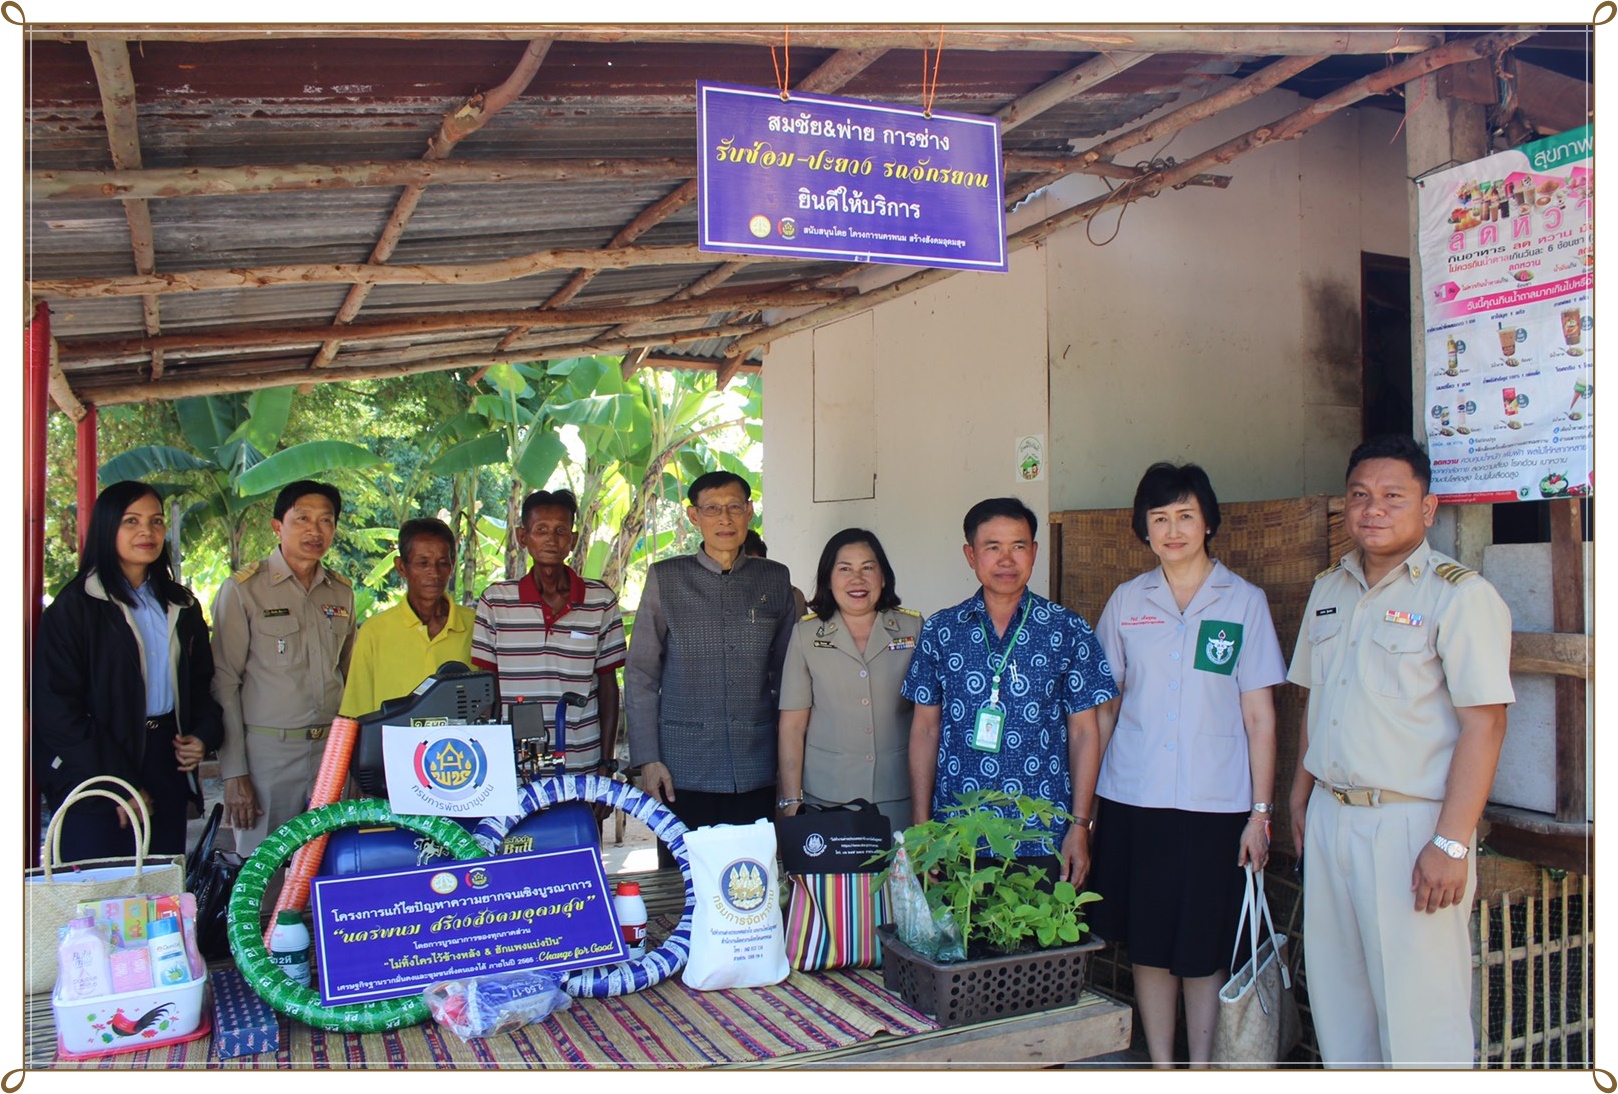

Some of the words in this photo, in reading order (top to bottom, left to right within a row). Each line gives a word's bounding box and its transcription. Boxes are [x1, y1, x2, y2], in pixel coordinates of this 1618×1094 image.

[768, 113, 875, 143] สมชัย&พ่าย
[883, 128, 950, 151] การช่าง
[716, 135, 872, 176] รับซ่อม-ปะยาง
[883, 156, 989, 189] รถจักรยาน
[798, 187, 920, 220] ยินดีให้บริการ
[803, 226, 847, 238] สนับสนุนโดย
[849, 227, 907, 242] โครงการนครพนม
[909, 233, 966, 248] สร้างสังคมอุดมสุข
[1448, 245, 1506, 263] กินอาหาร
[1538, 229, 1572, 244] หวาน
[411, 784, 494, 812] กรมการพัฒนาชุมชน
[331, 880, 592, 922] โครงการแก้ไขปัญหาความยากจนเชิงบูรณาการ
[712, 889, 774, 926] กรมการจัดหางาน
[413, 928, 531, 950] โดยการบูรณาการของทุกภาคส่วน
[485, 948, 492, 956] &
[489, 958, 516, 970] ภายในปี
[538, 950, 573, 962] Change
[574, 946, 590, 959] for
[590, 941, 614, 954] Good
[511, 983, 544, 999] 2.50-17
